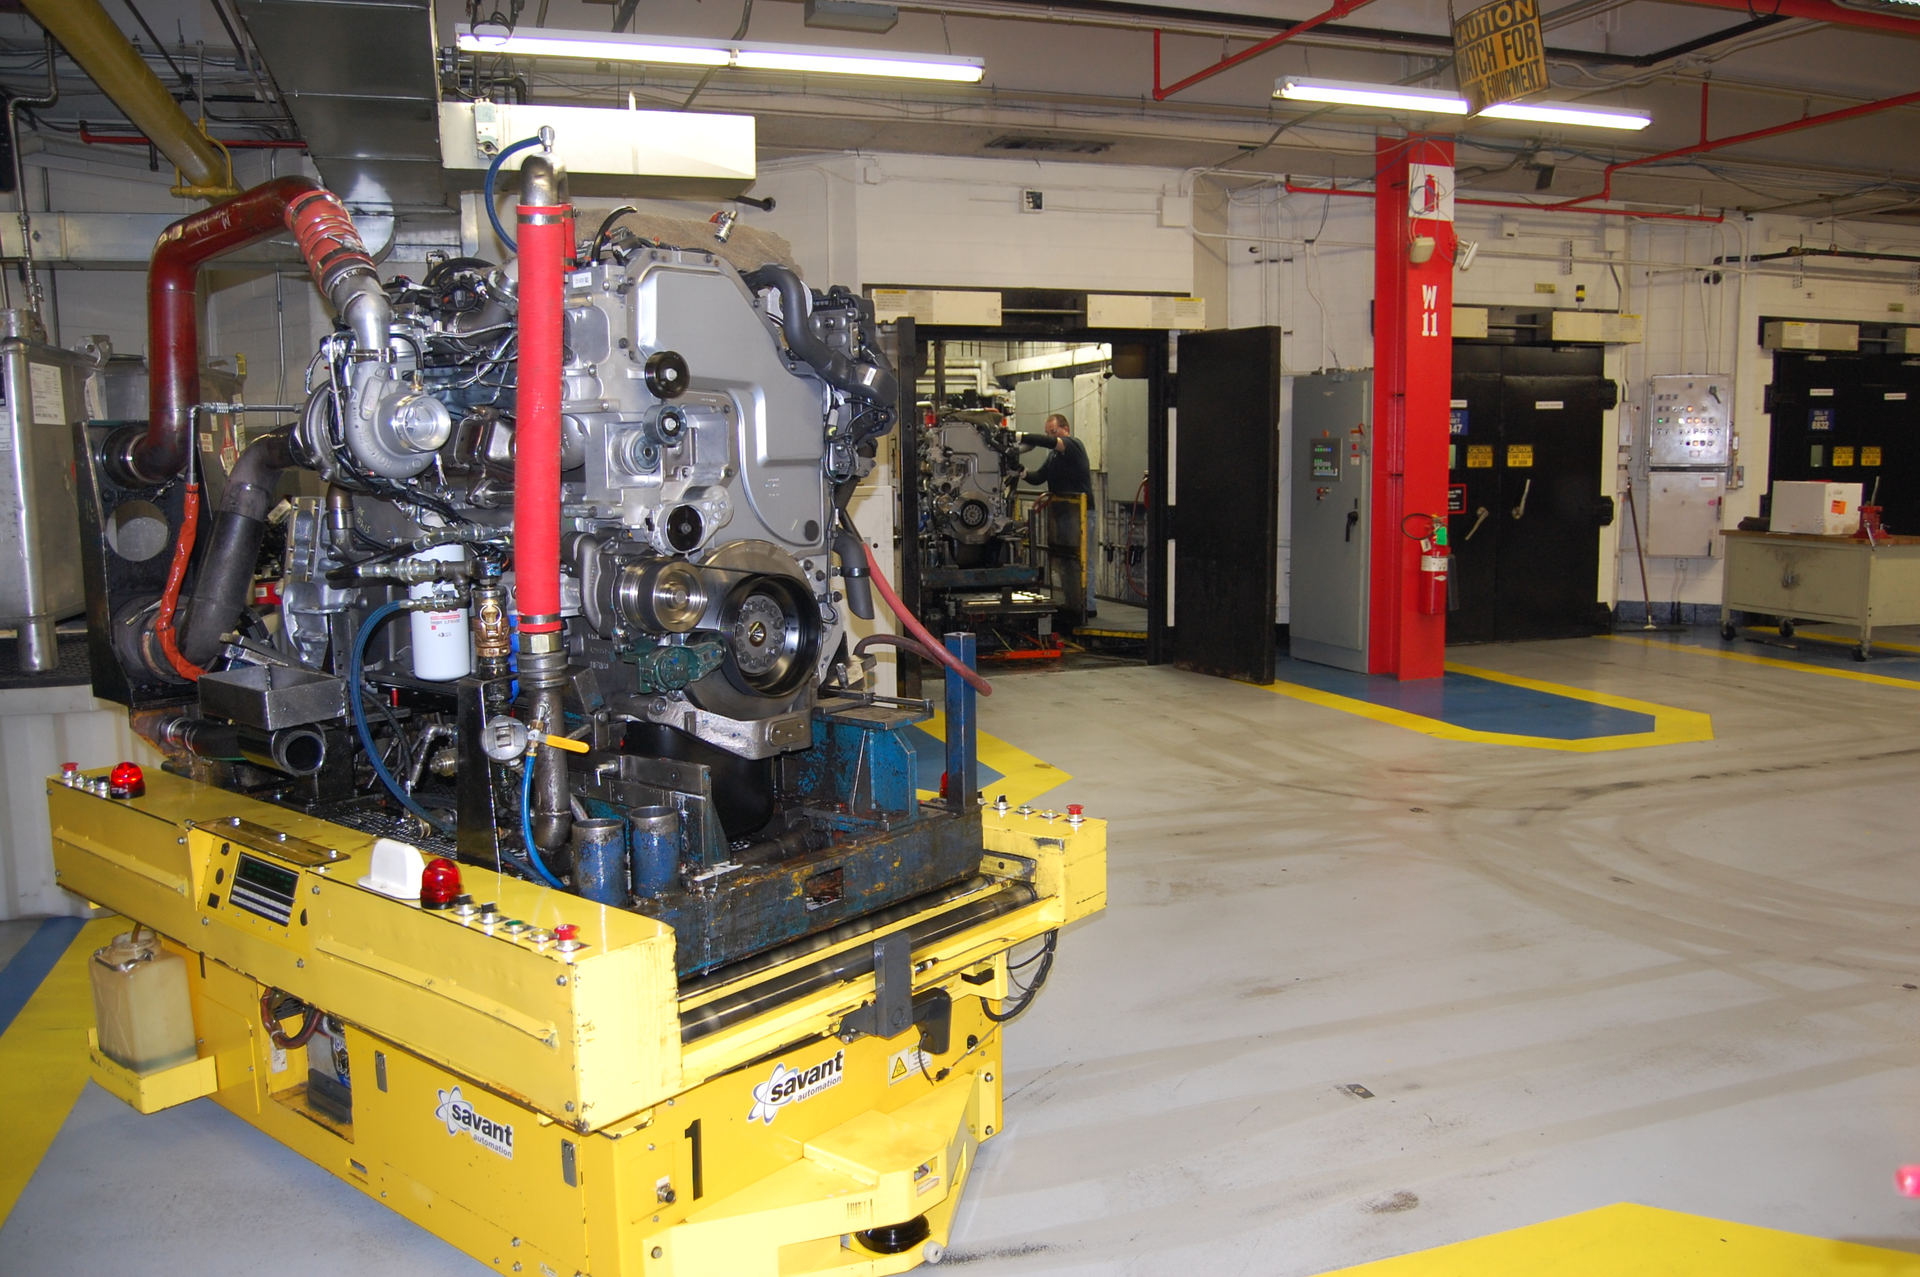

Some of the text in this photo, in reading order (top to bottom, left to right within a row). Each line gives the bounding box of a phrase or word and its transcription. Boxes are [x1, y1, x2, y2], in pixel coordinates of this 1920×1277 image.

[1454, 0, 1535, 48] CAUTION
[1500, 22, 1540, 66] FOR
[1486, 58, 1541, 103] EQUIPMENT
[1422, 284, 1438, 310] W
[1422, 311, 1438, 337] 11
[771, 1050, 844, 1103] savant
[797, 1075, 842, 1102] automation
[452, 1103, 513, 1148] savant
[473, 1133, 512, 1159] automation
[684, 1117, 704, 1202] 1
